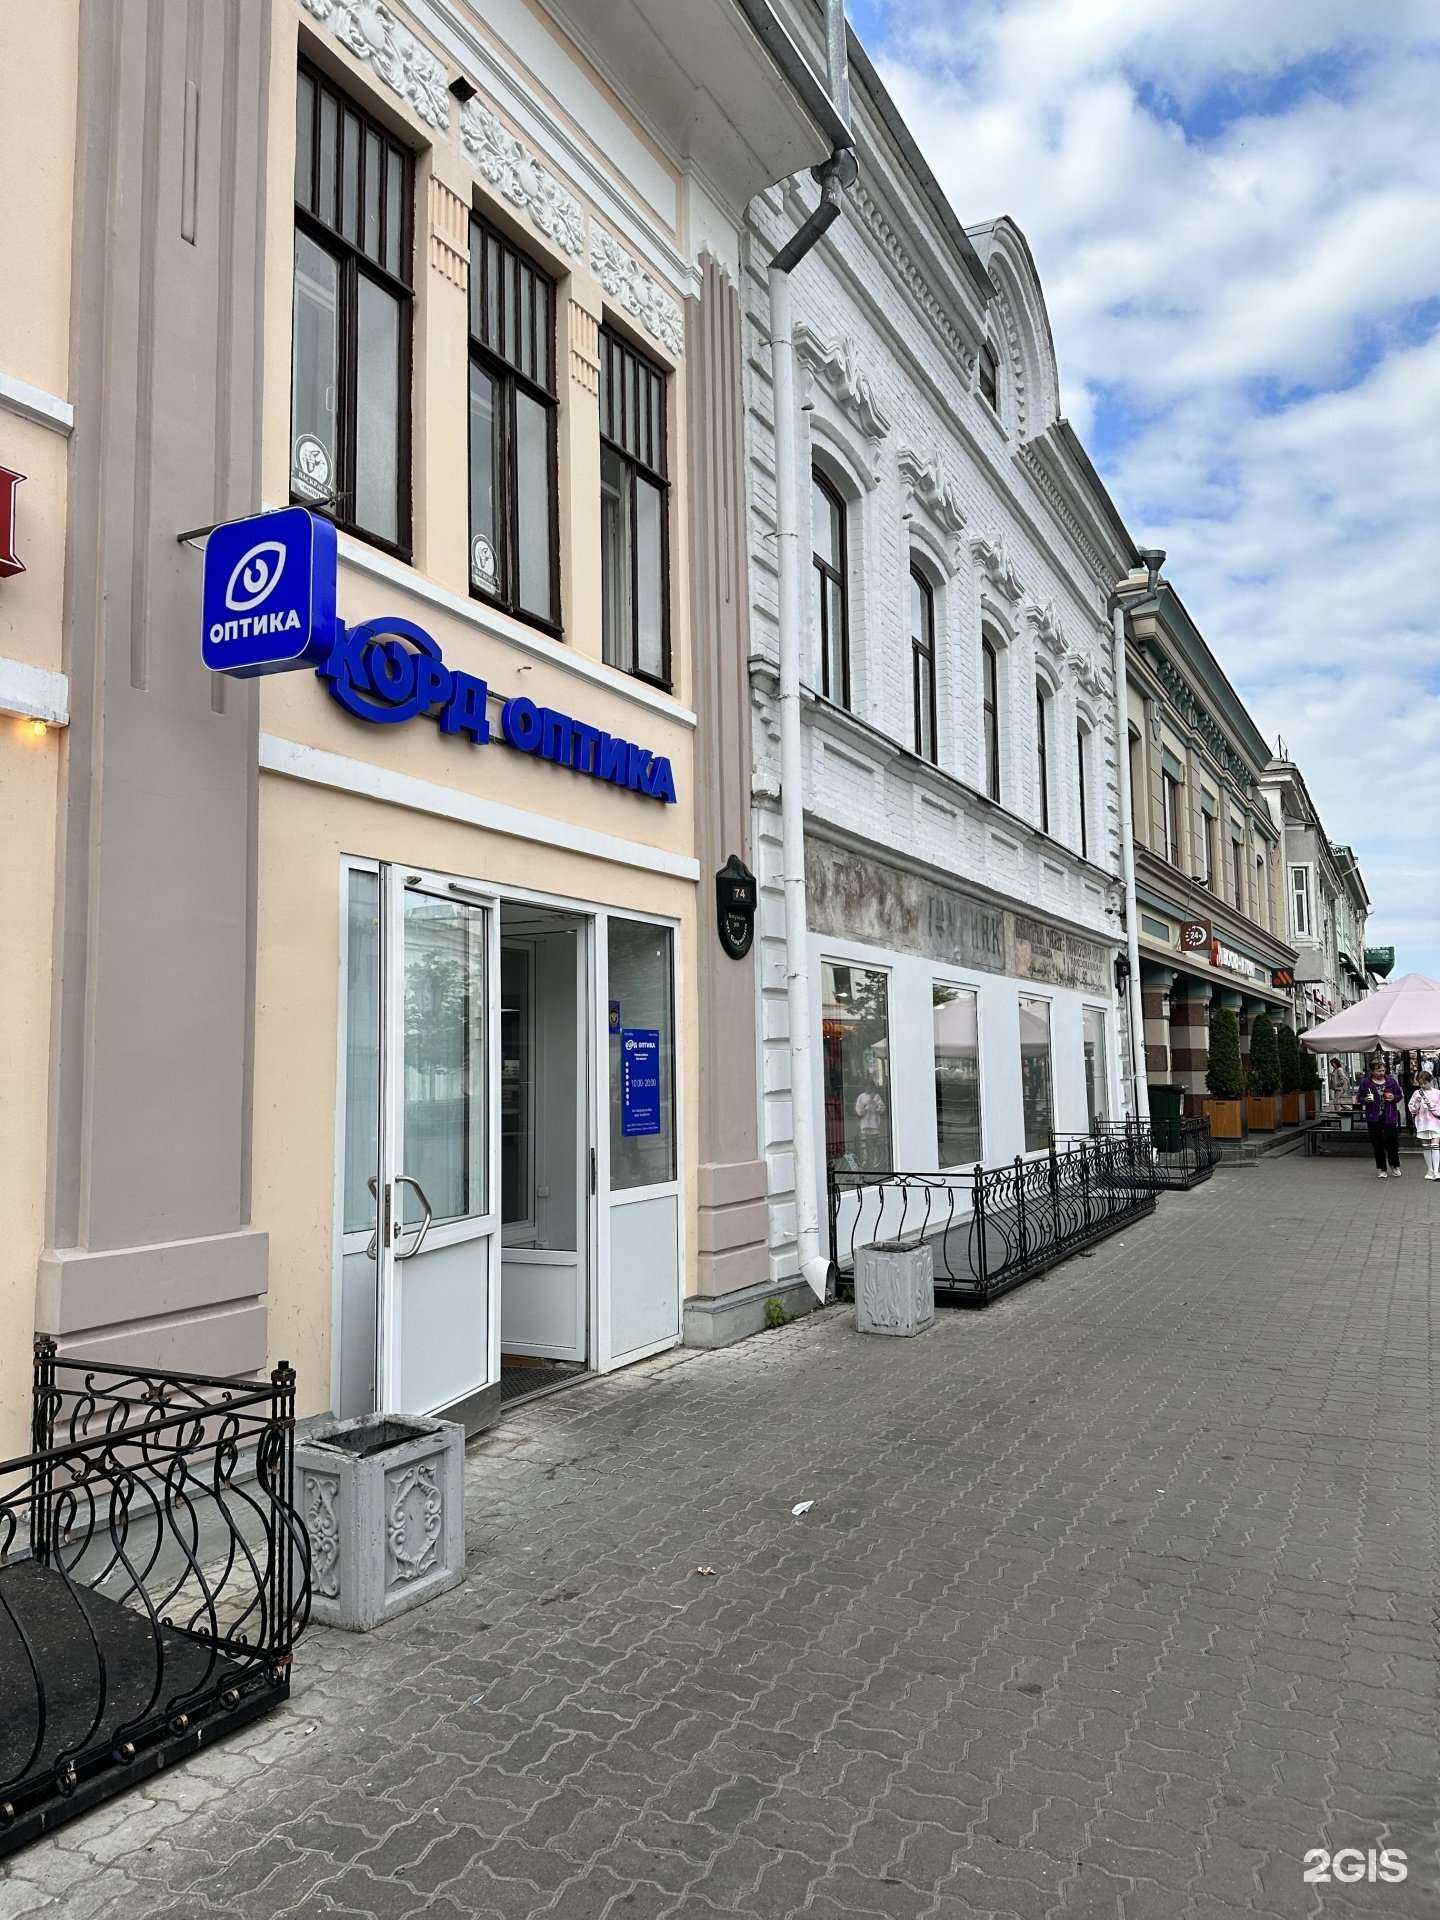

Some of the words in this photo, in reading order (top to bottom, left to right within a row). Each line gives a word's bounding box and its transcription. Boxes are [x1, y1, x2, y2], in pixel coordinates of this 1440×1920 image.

[209, 608, 301, 644] ОПТИКА
[316, 616, 489, 745] КОРД
[502, 696, 678, 804] ОПТИКА
[733, 887, 746, 899] 74
